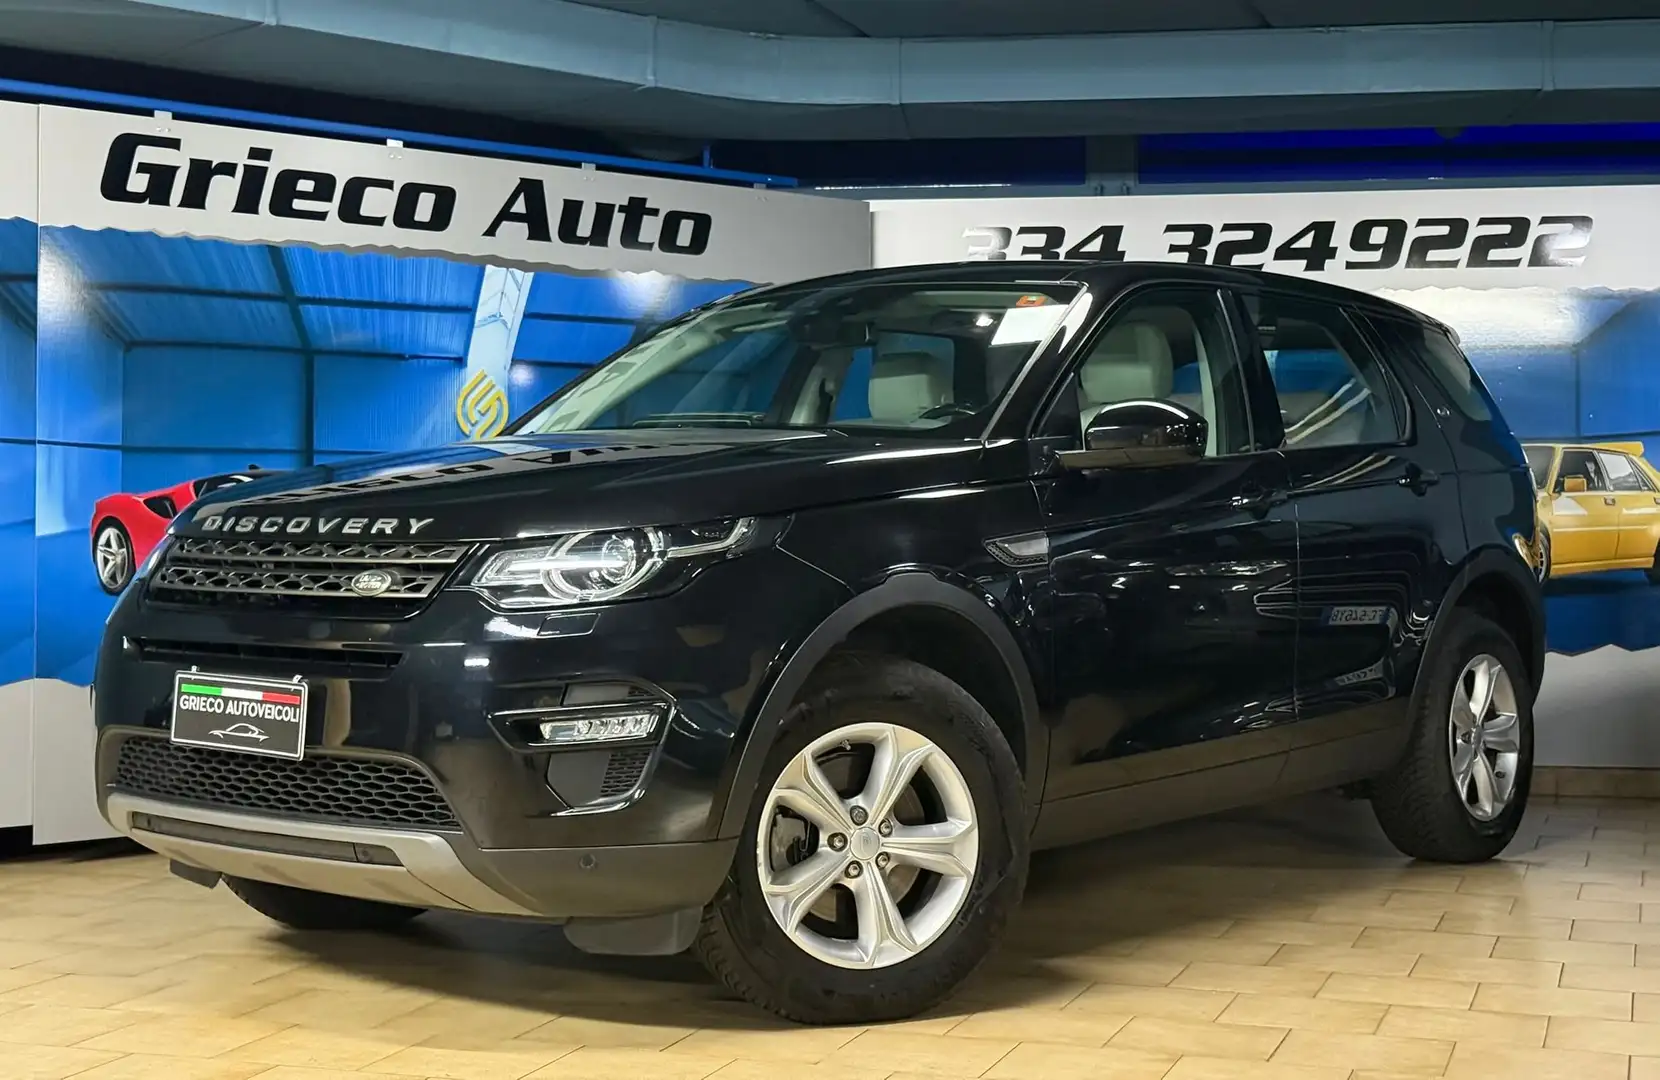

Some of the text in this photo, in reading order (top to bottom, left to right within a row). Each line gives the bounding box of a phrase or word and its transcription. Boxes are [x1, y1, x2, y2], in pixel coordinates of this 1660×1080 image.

[100, 132, 712, 256] Grieco Auto
[962, 215, 1593, 272] 334 3249222
[202, 515, 434, 535] DISCOVERY
[179, 694, 300, 723] GRIECO AUTOVEICOLI
